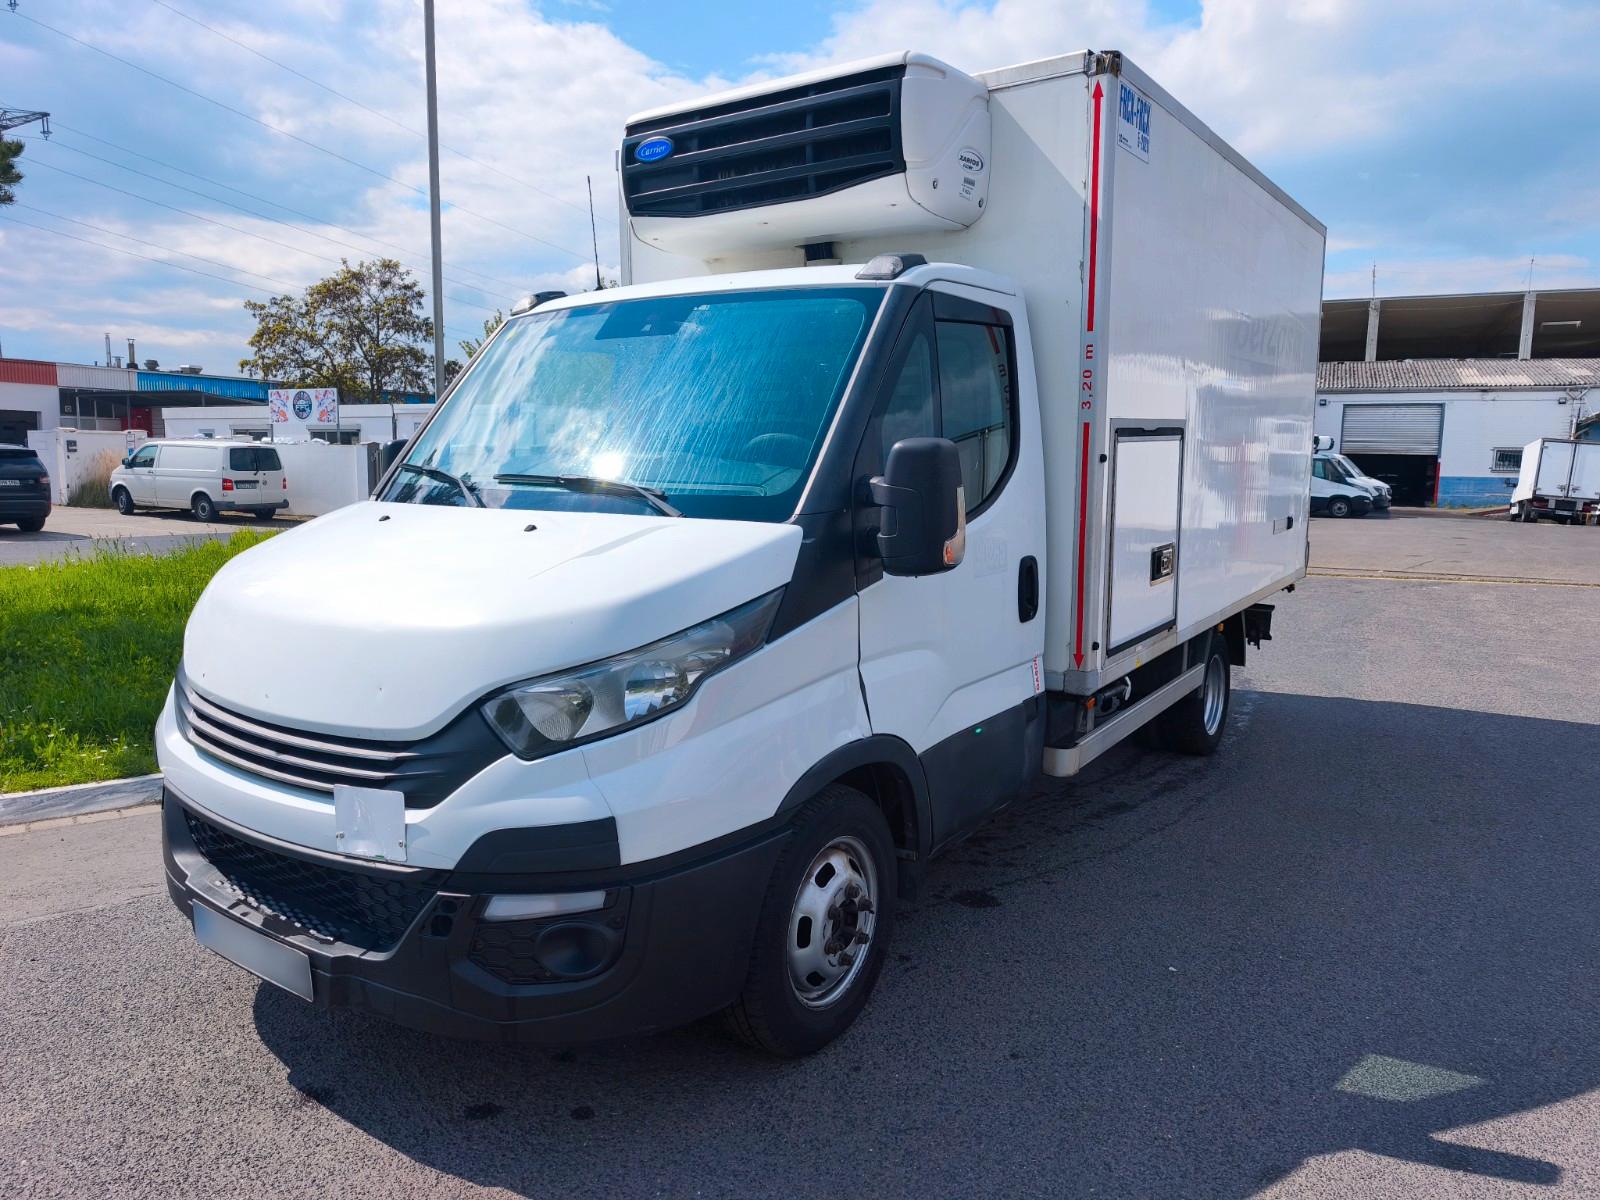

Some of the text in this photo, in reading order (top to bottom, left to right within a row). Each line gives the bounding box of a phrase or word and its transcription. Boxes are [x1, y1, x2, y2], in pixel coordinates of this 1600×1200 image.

[640, 145, 666, 157] Carrier
[1081, 343, 1094, 410] 3,20 m
